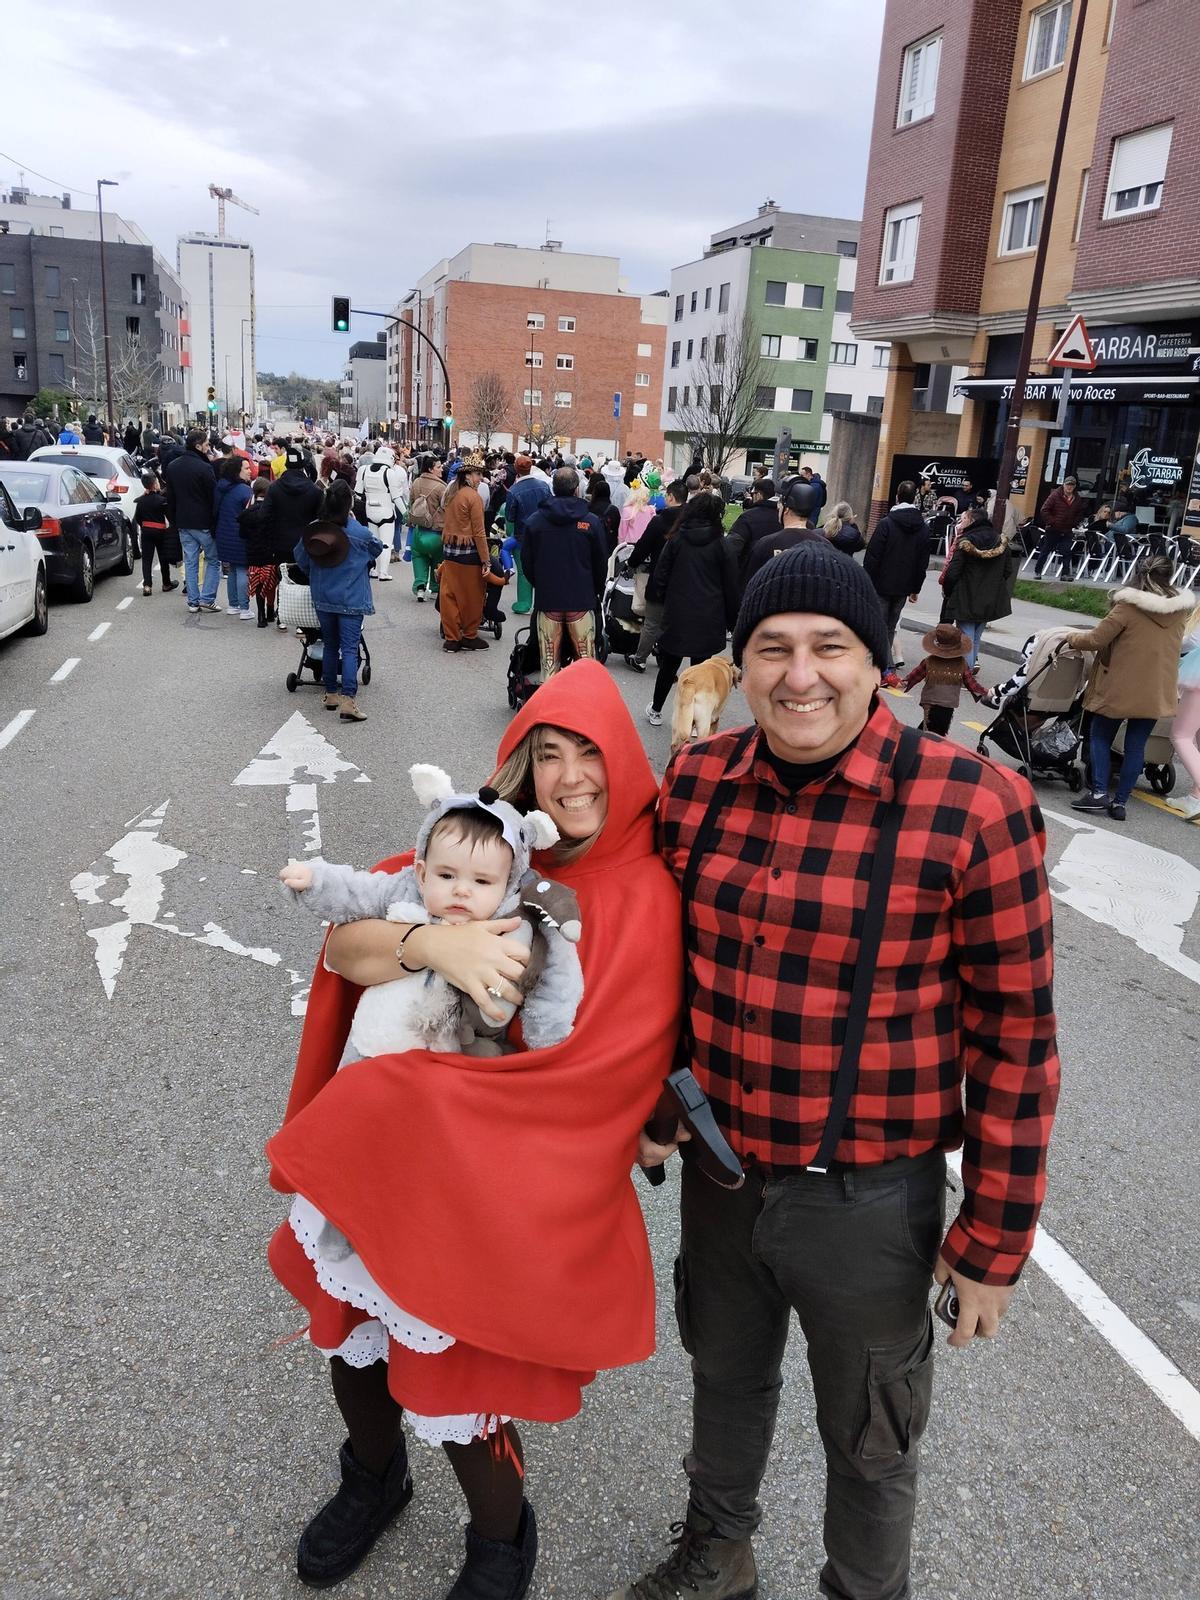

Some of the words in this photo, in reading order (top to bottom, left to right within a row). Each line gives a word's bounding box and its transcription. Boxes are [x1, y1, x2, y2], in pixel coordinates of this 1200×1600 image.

[1088, 335, 1157, 360] TARBAR
[1158, 338, 1191, 346] CAFETERIA
[1157, 348, 1173, 357] NUEVO
[1174, 347, 1189, 357] ROCES
[1001, 385, 1047, 399] STBAR
[1084, 385, 1116, 400] Roces
[1151, 456, 1178, 464] CAFETERIA
[1147, 467, 1183, 480] STARBAR
